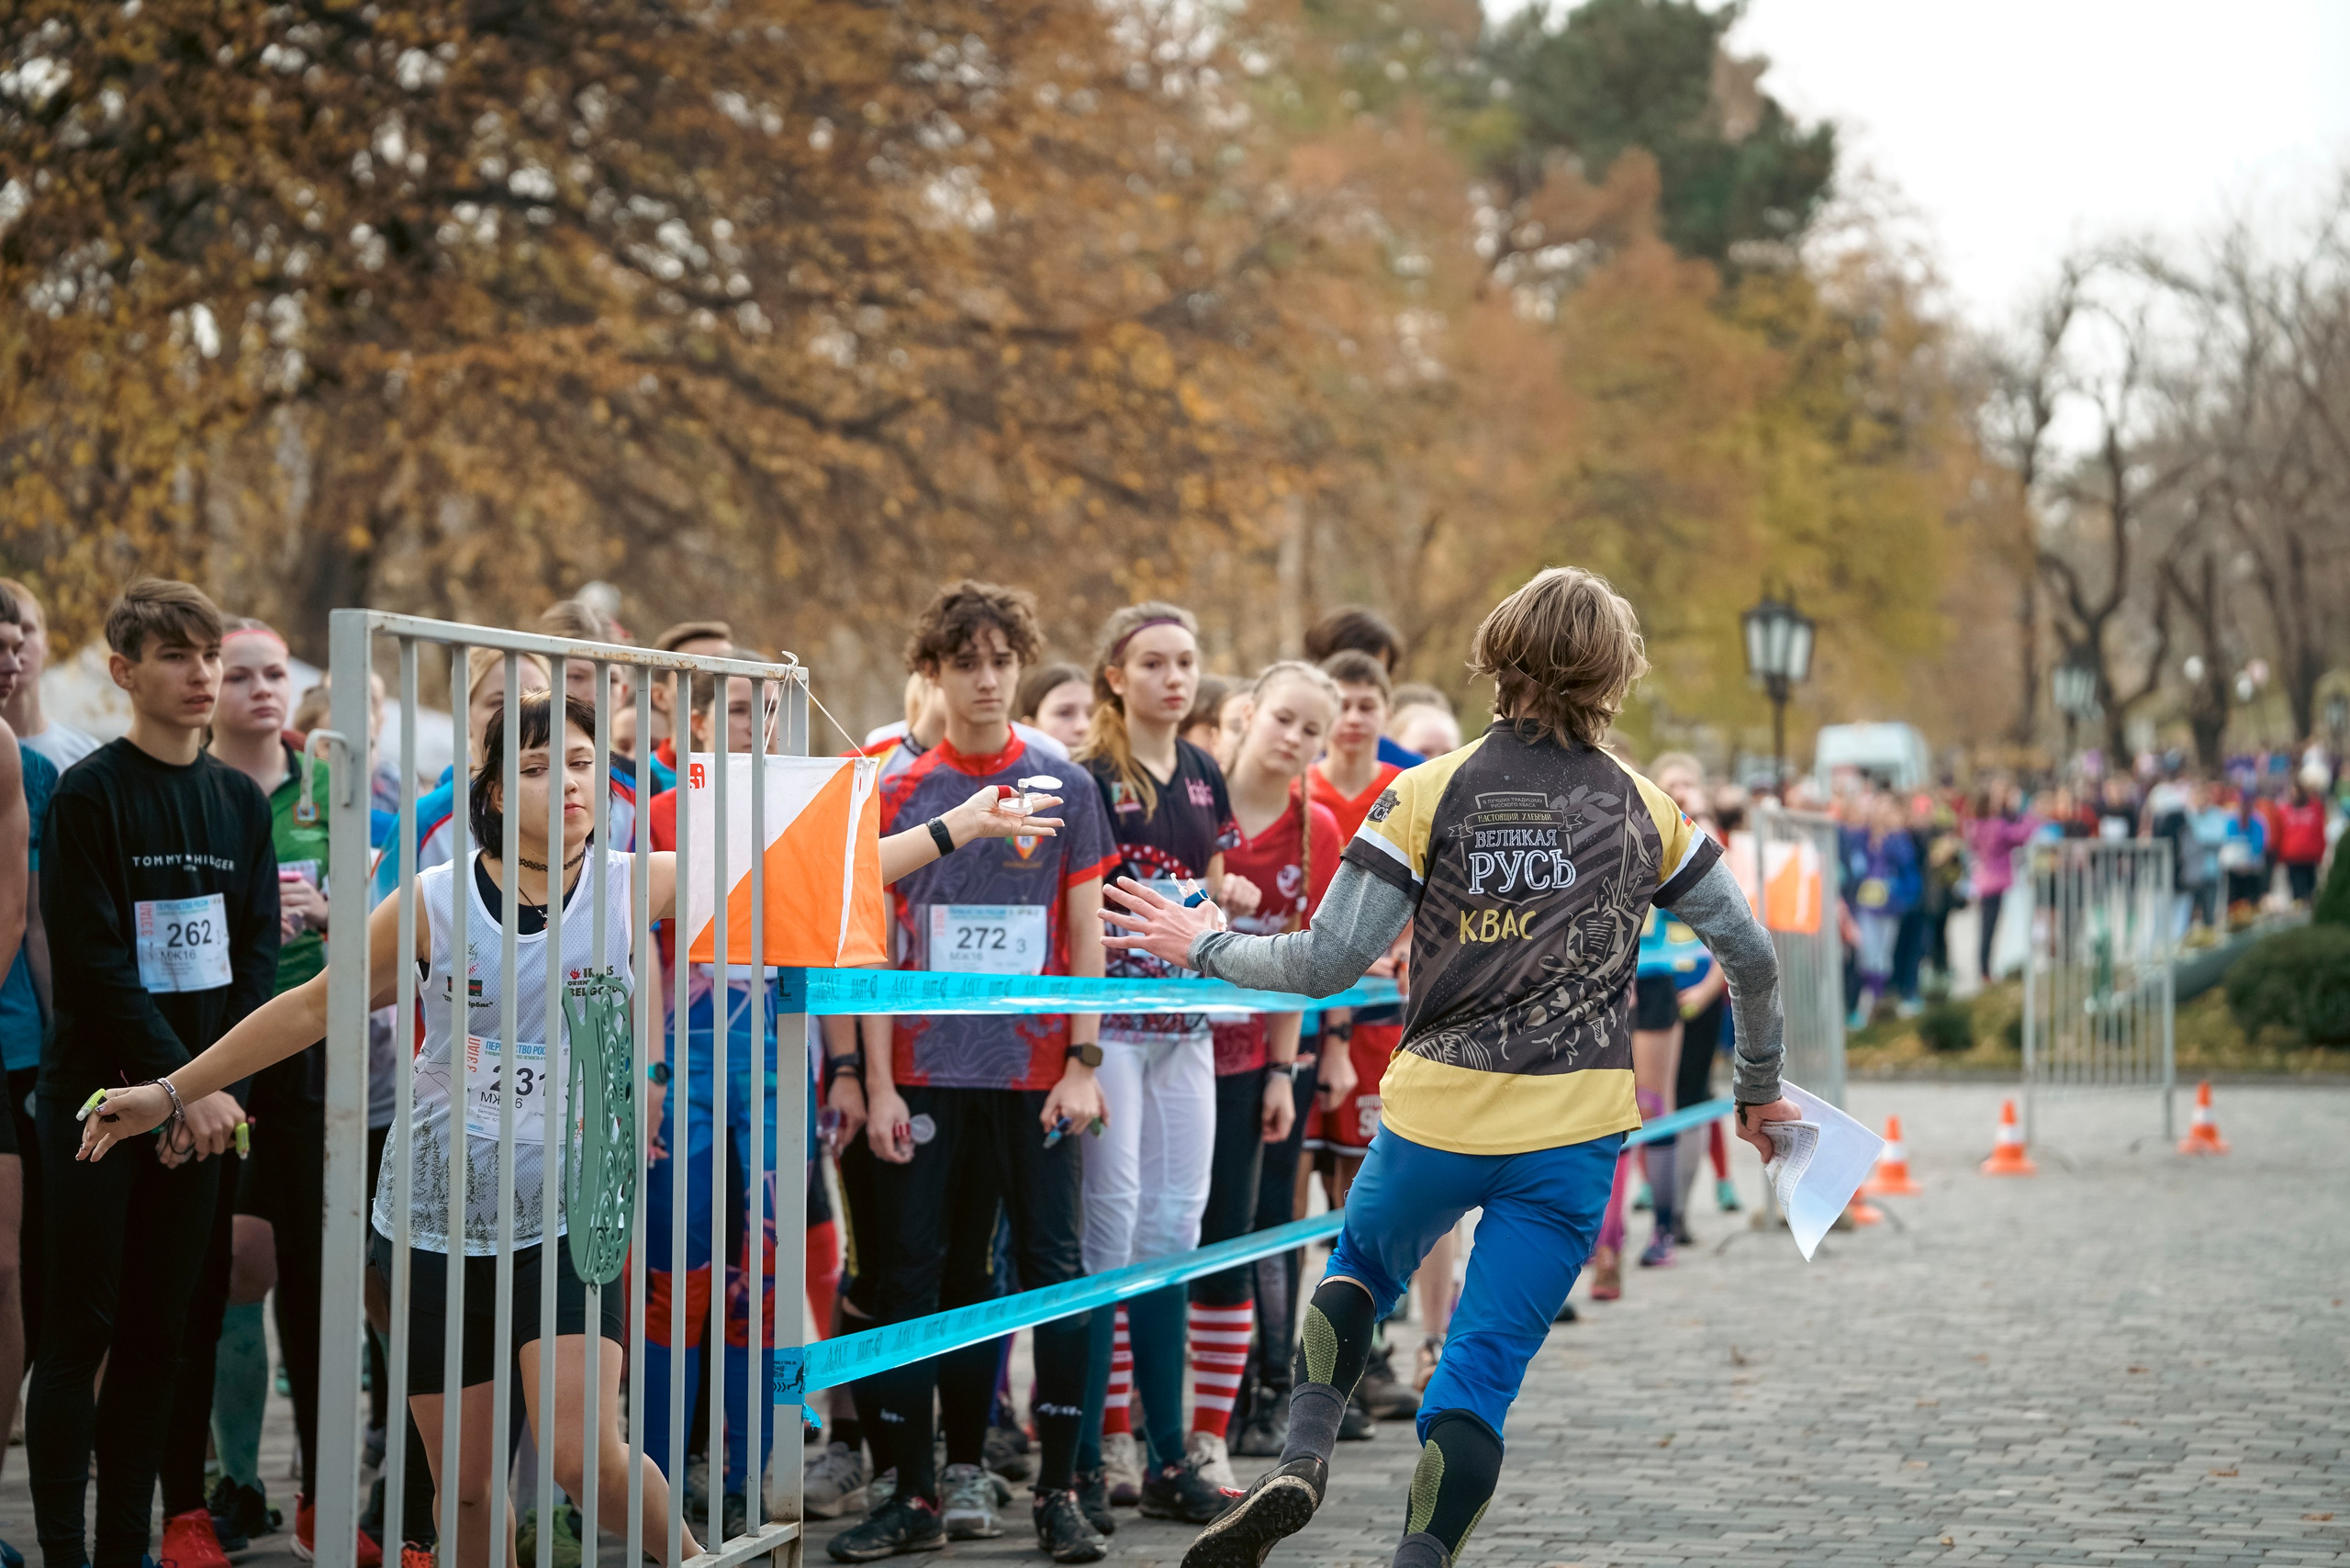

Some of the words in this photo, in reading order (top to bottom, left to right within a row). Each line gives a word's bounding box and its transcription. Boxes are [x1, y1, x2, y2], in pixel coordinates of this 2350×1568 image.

[1477, 812, 1519, 823] НАСТОЯЩИЙ
[1475, 829, 1557, 848] ВЕЛИКАЯ
[132, 854, 182, 867] TOMMY
[1469, 849, 1577, 895] РУСЬ
[167, 919, 212, 948] 262
[1459, 908, 1537, 944] КВАС
[957, 926, 1006, 950] 272
[1016, 937, 1027, 954] 3
[583, 965, 614, 978] IRIS
[467, 1037, 481, 1064] ЭТАП
[467, 1064, 477, 1073] 3
